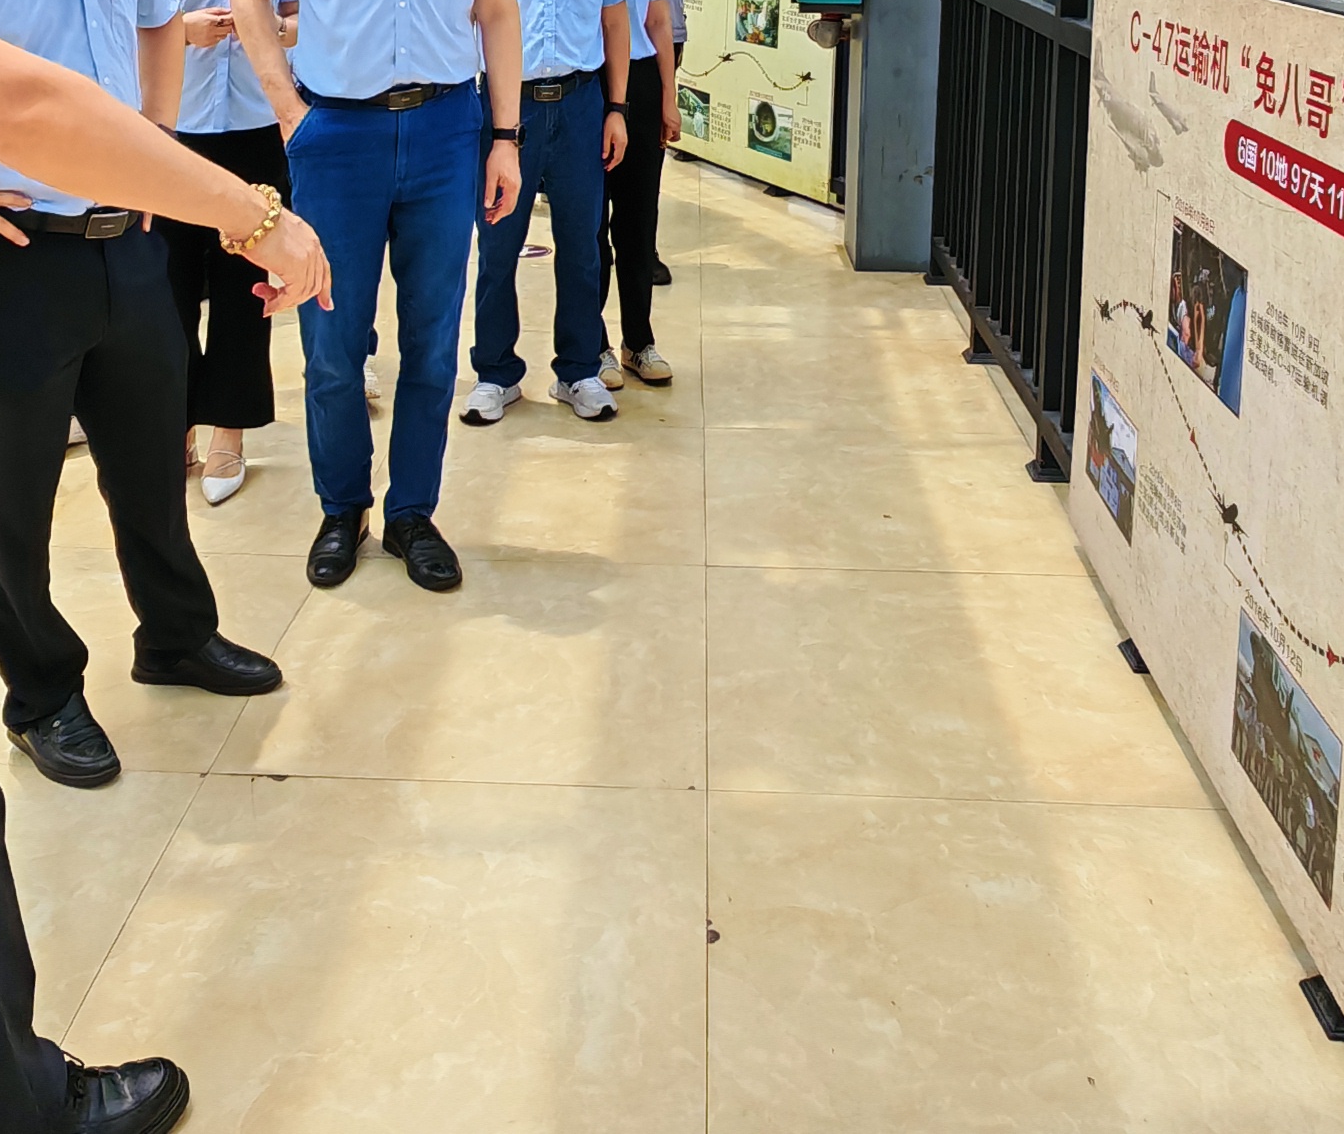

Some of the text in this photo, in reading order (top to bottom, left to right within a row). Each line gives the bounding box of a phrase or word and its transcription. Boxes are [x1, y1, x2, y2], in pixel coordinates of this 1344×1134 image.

[1237, 136, 1258, 173] 6国
[1260, 148, 1288, 189] 10地
[1290, 163, 1325, 210] 97天
